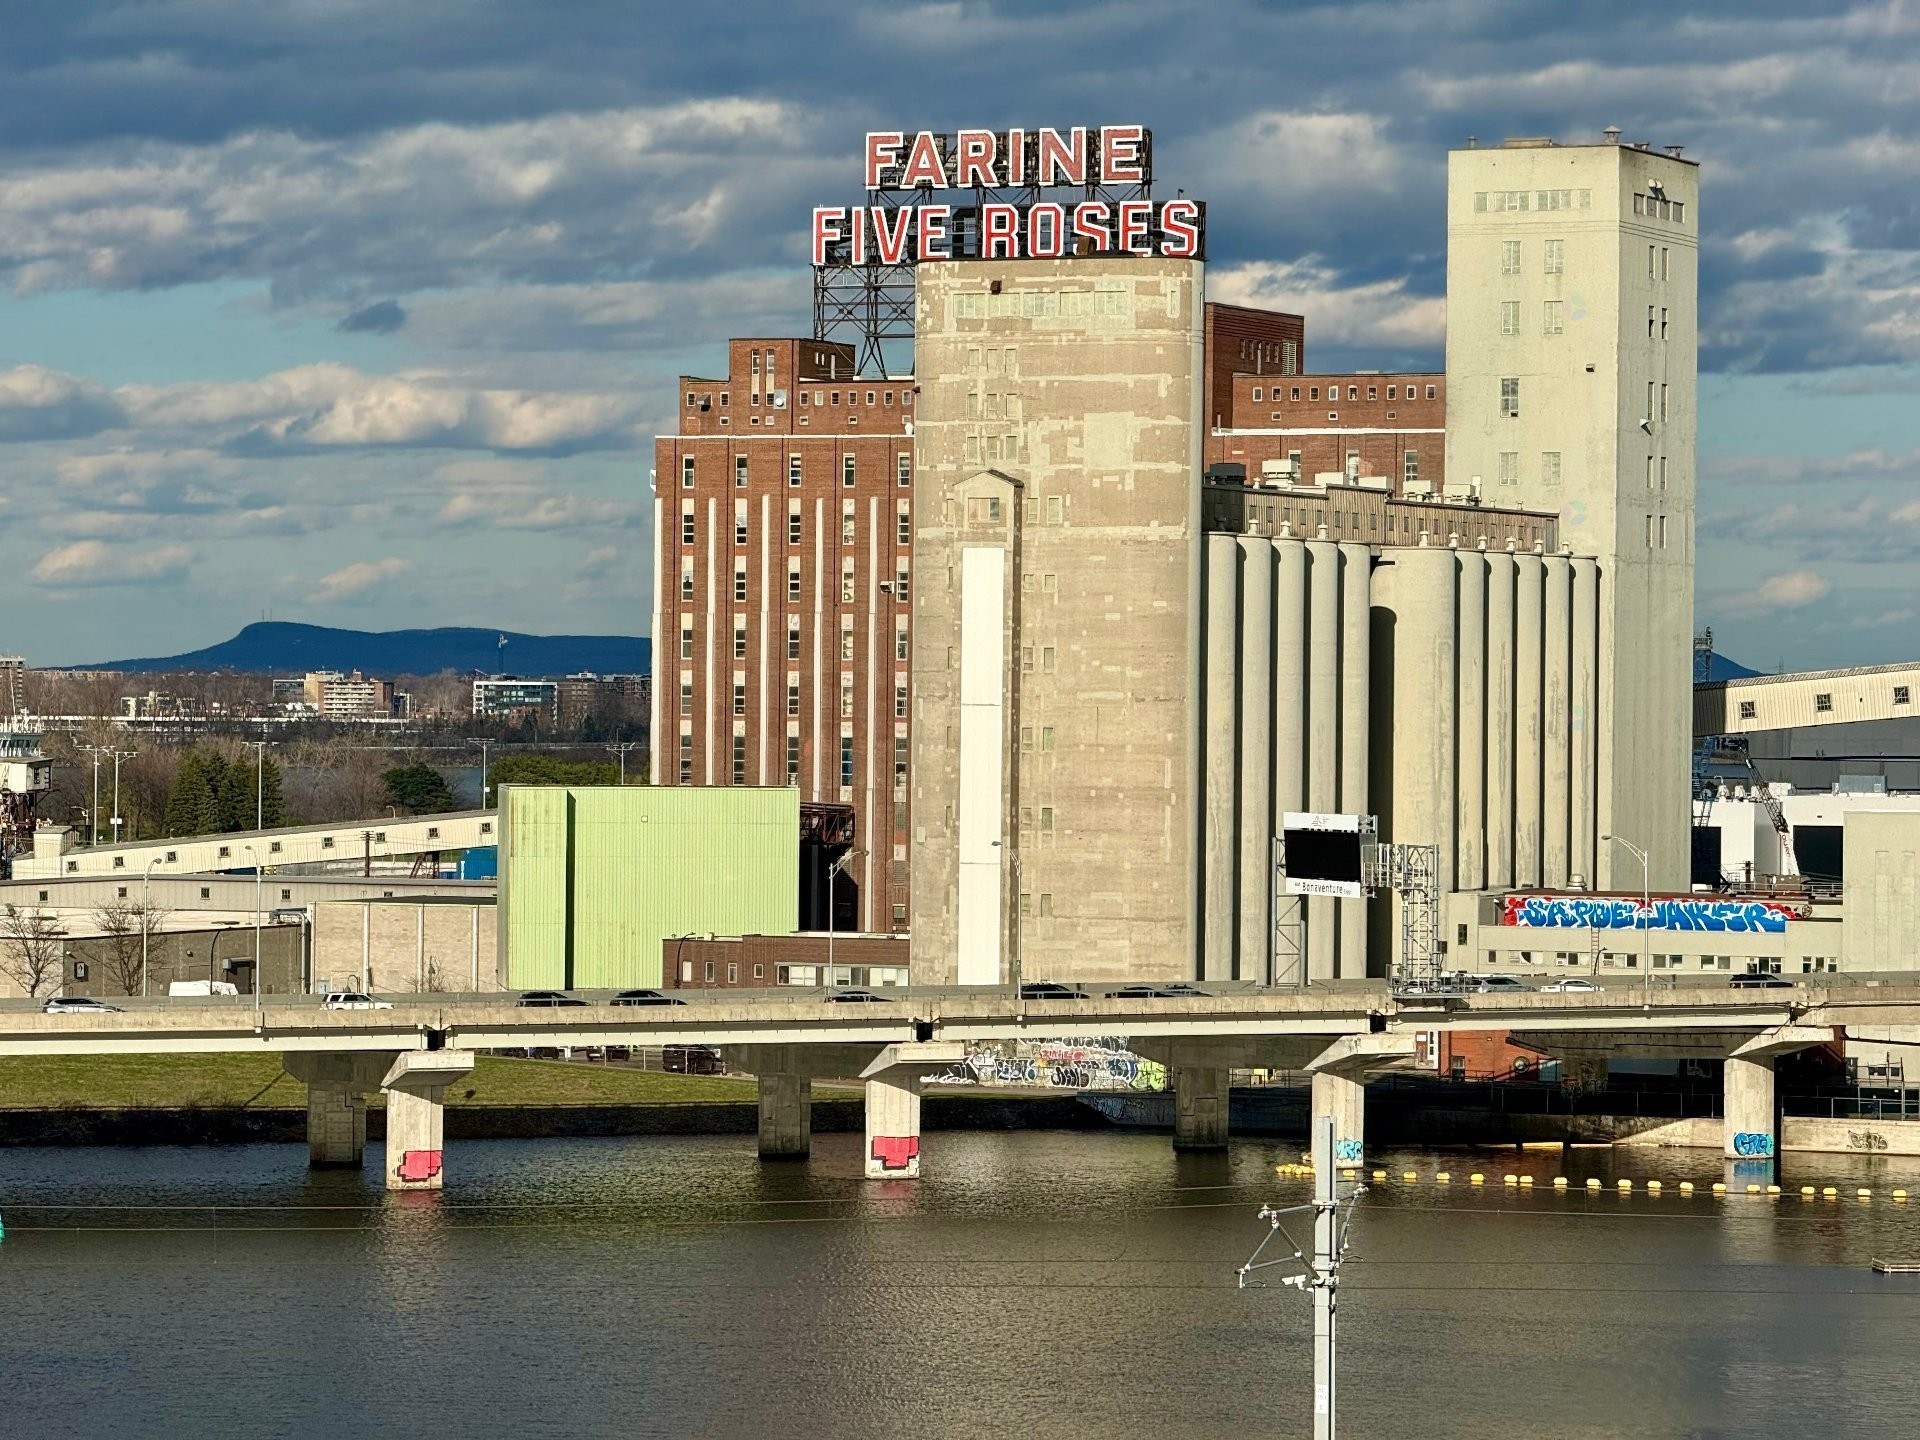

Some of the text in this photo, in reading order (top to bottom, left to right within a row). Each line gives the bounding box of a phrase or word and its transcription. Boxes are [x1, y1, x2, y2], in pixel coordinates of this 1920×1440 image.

[865, 125, 1144, 190] FARINE
[812, 199, 1199, 266] FIVE ROSES
[1302, 882, 1343, 894] Bonaventure
